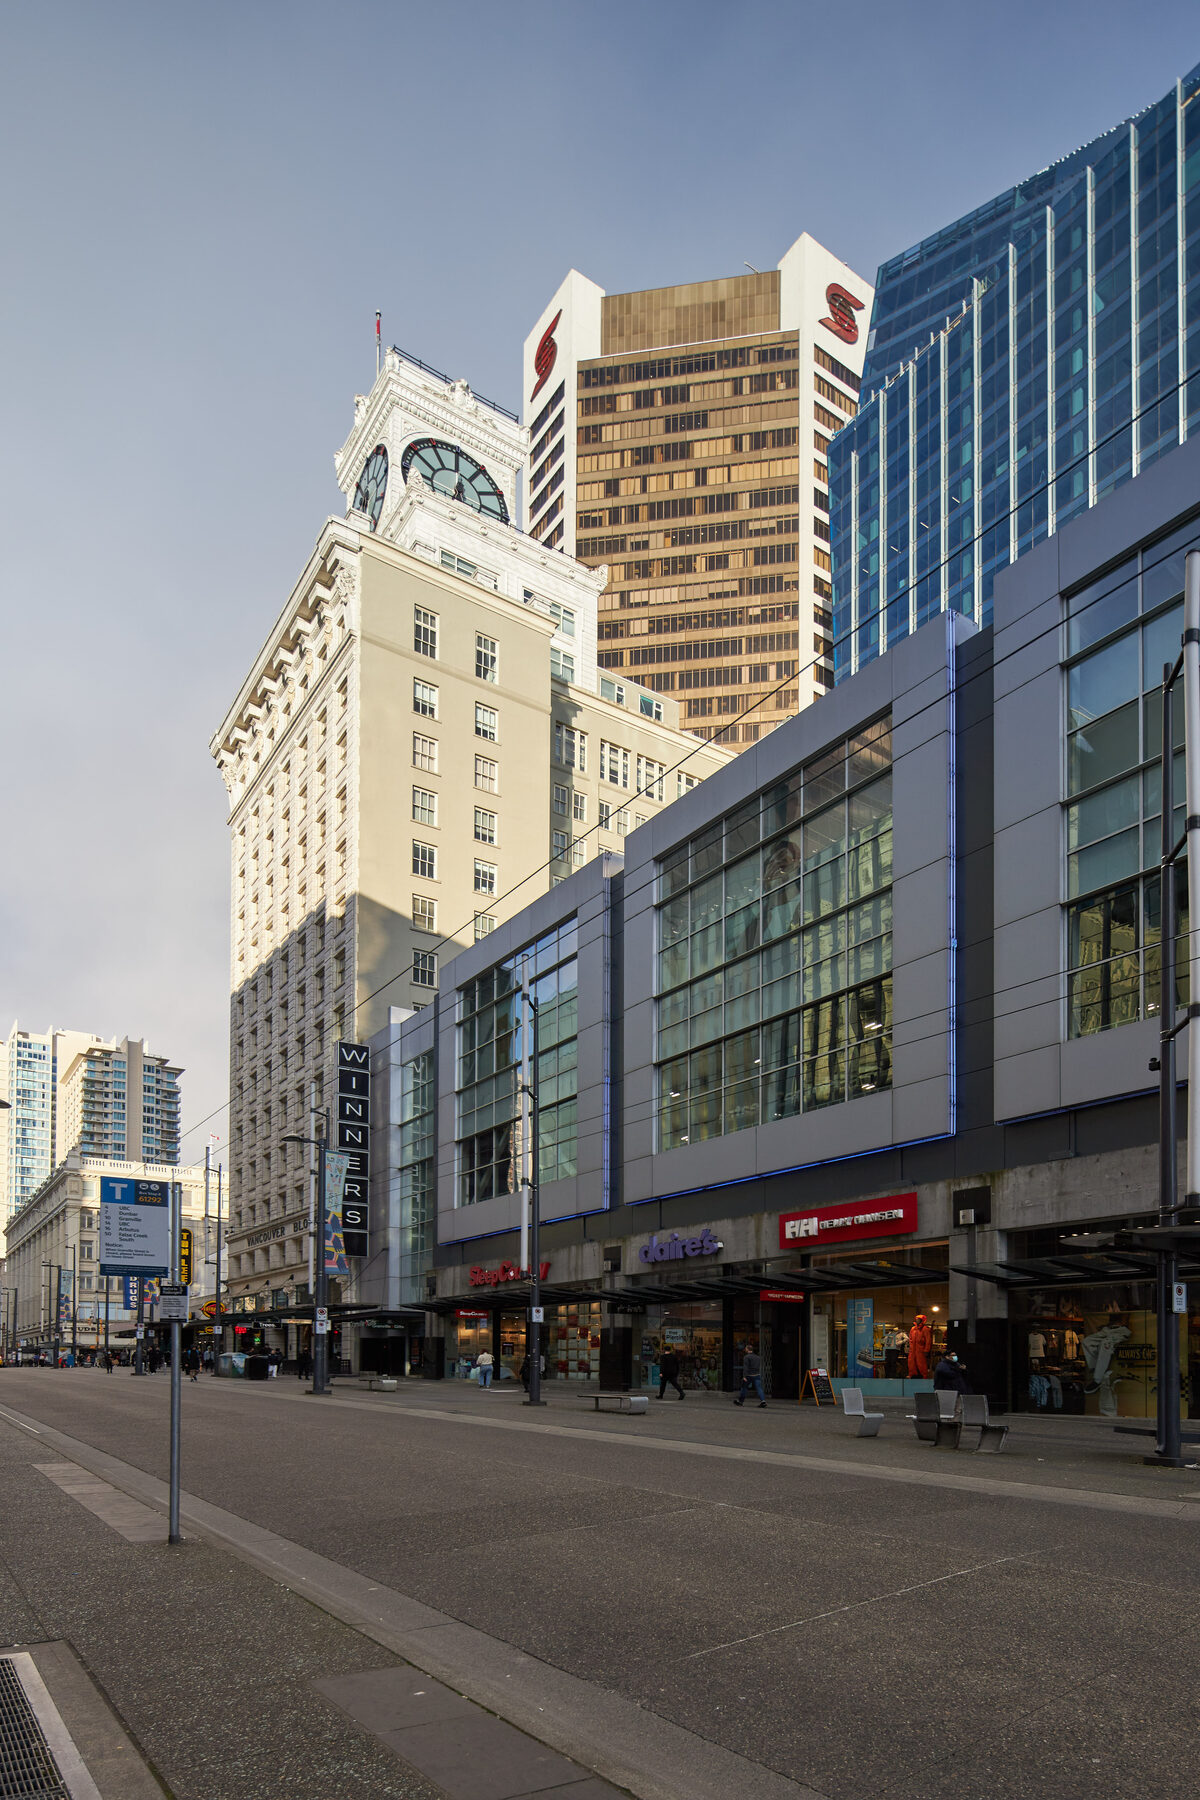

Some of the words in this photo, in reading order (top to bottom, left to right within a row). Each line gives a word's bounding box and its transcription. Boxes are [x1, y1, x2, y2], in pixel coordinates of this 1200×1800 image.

[341, 1047, 367, 1224] WINNERS
[109, 1182, 128, 1200] T
[247, 1226, 285, 1247] VANCOUVER
[638, 1228, 719, 1264] claire's
